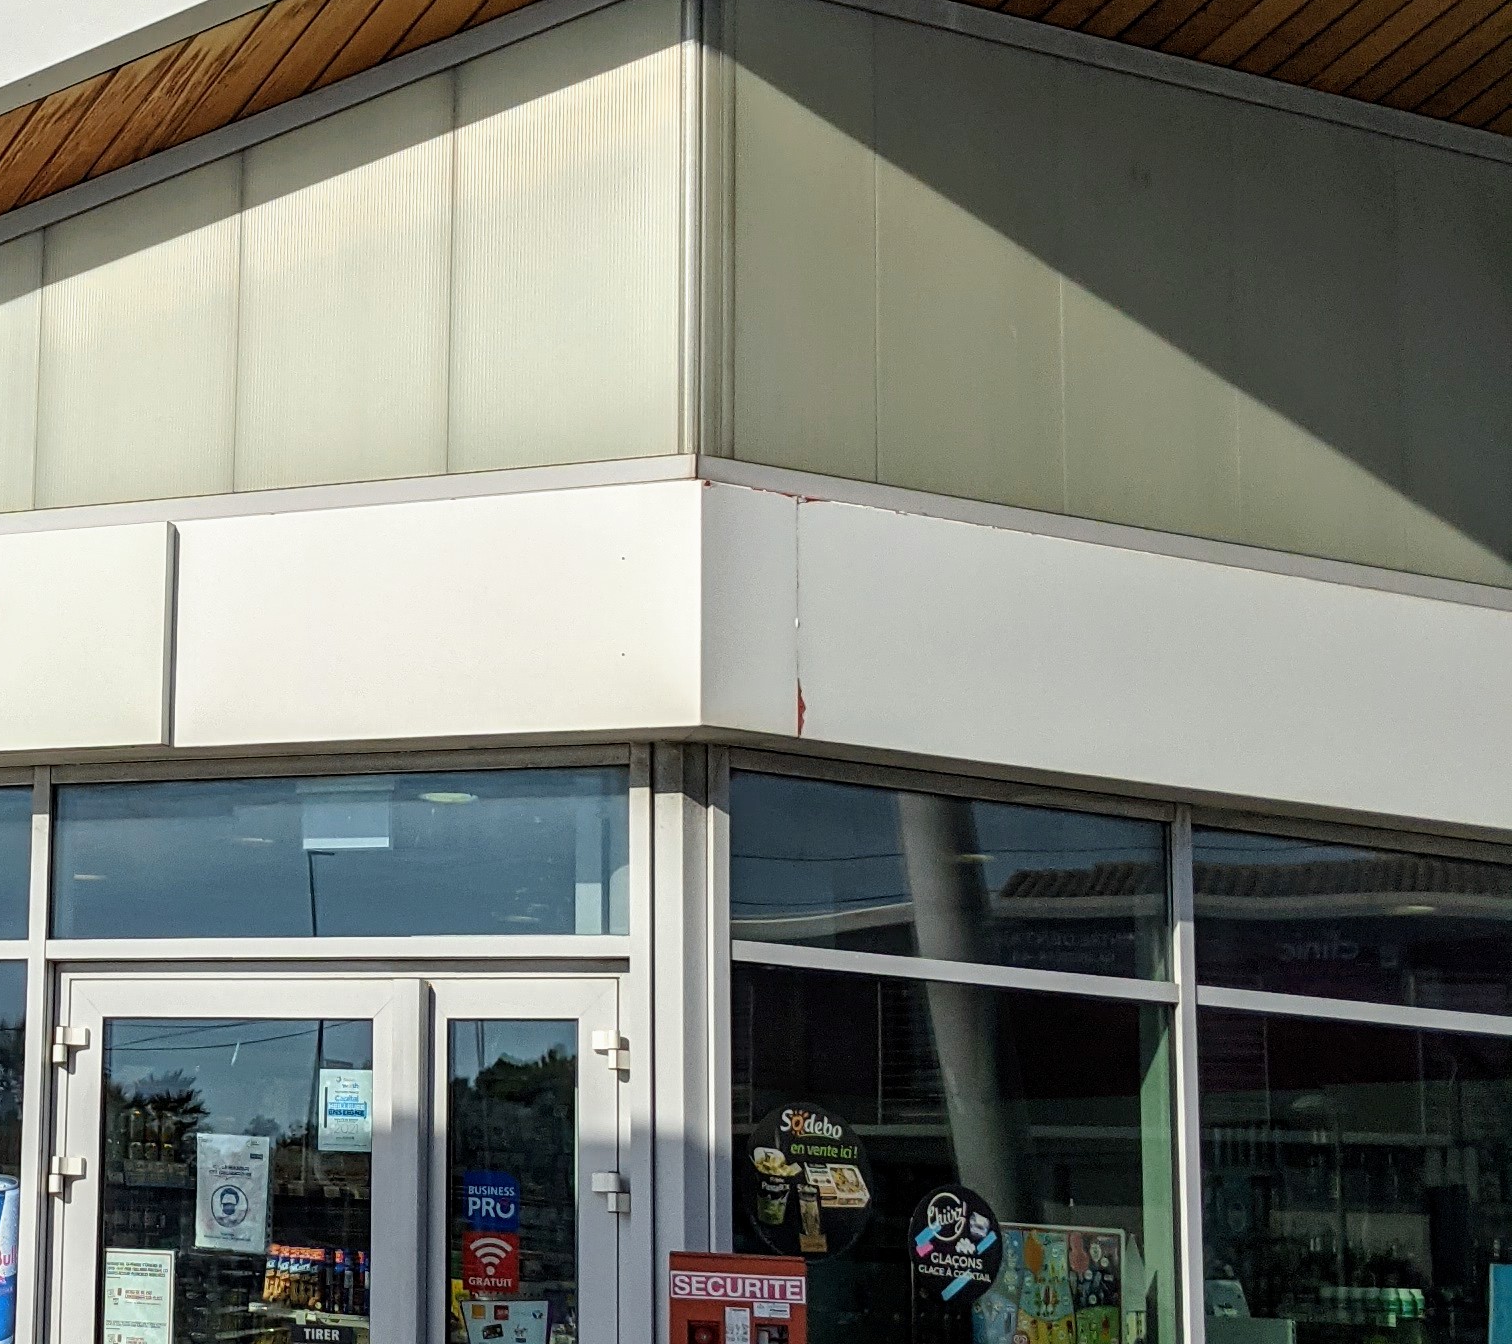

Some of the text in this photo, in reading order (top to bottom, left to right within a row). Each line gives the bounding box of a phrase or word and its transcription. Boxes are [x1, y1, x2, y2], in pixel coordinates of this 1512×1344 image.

[790, 1143, 805, 1154] en
[807, 1145, 837, 1157] vente
[468, 1185, 515, 1196] BUSINESS
[468, 1197, 515, 1219] PRO
[930, 1252, 983, 1270] GLAÇONS
[918, 1264, 945, 1276] GLACE
[469, 1277, 512, 1288] GRATUIT
[674, 1275, 803, 1300] SECURITE
[303, 1328, 340, 1341] TIRER
